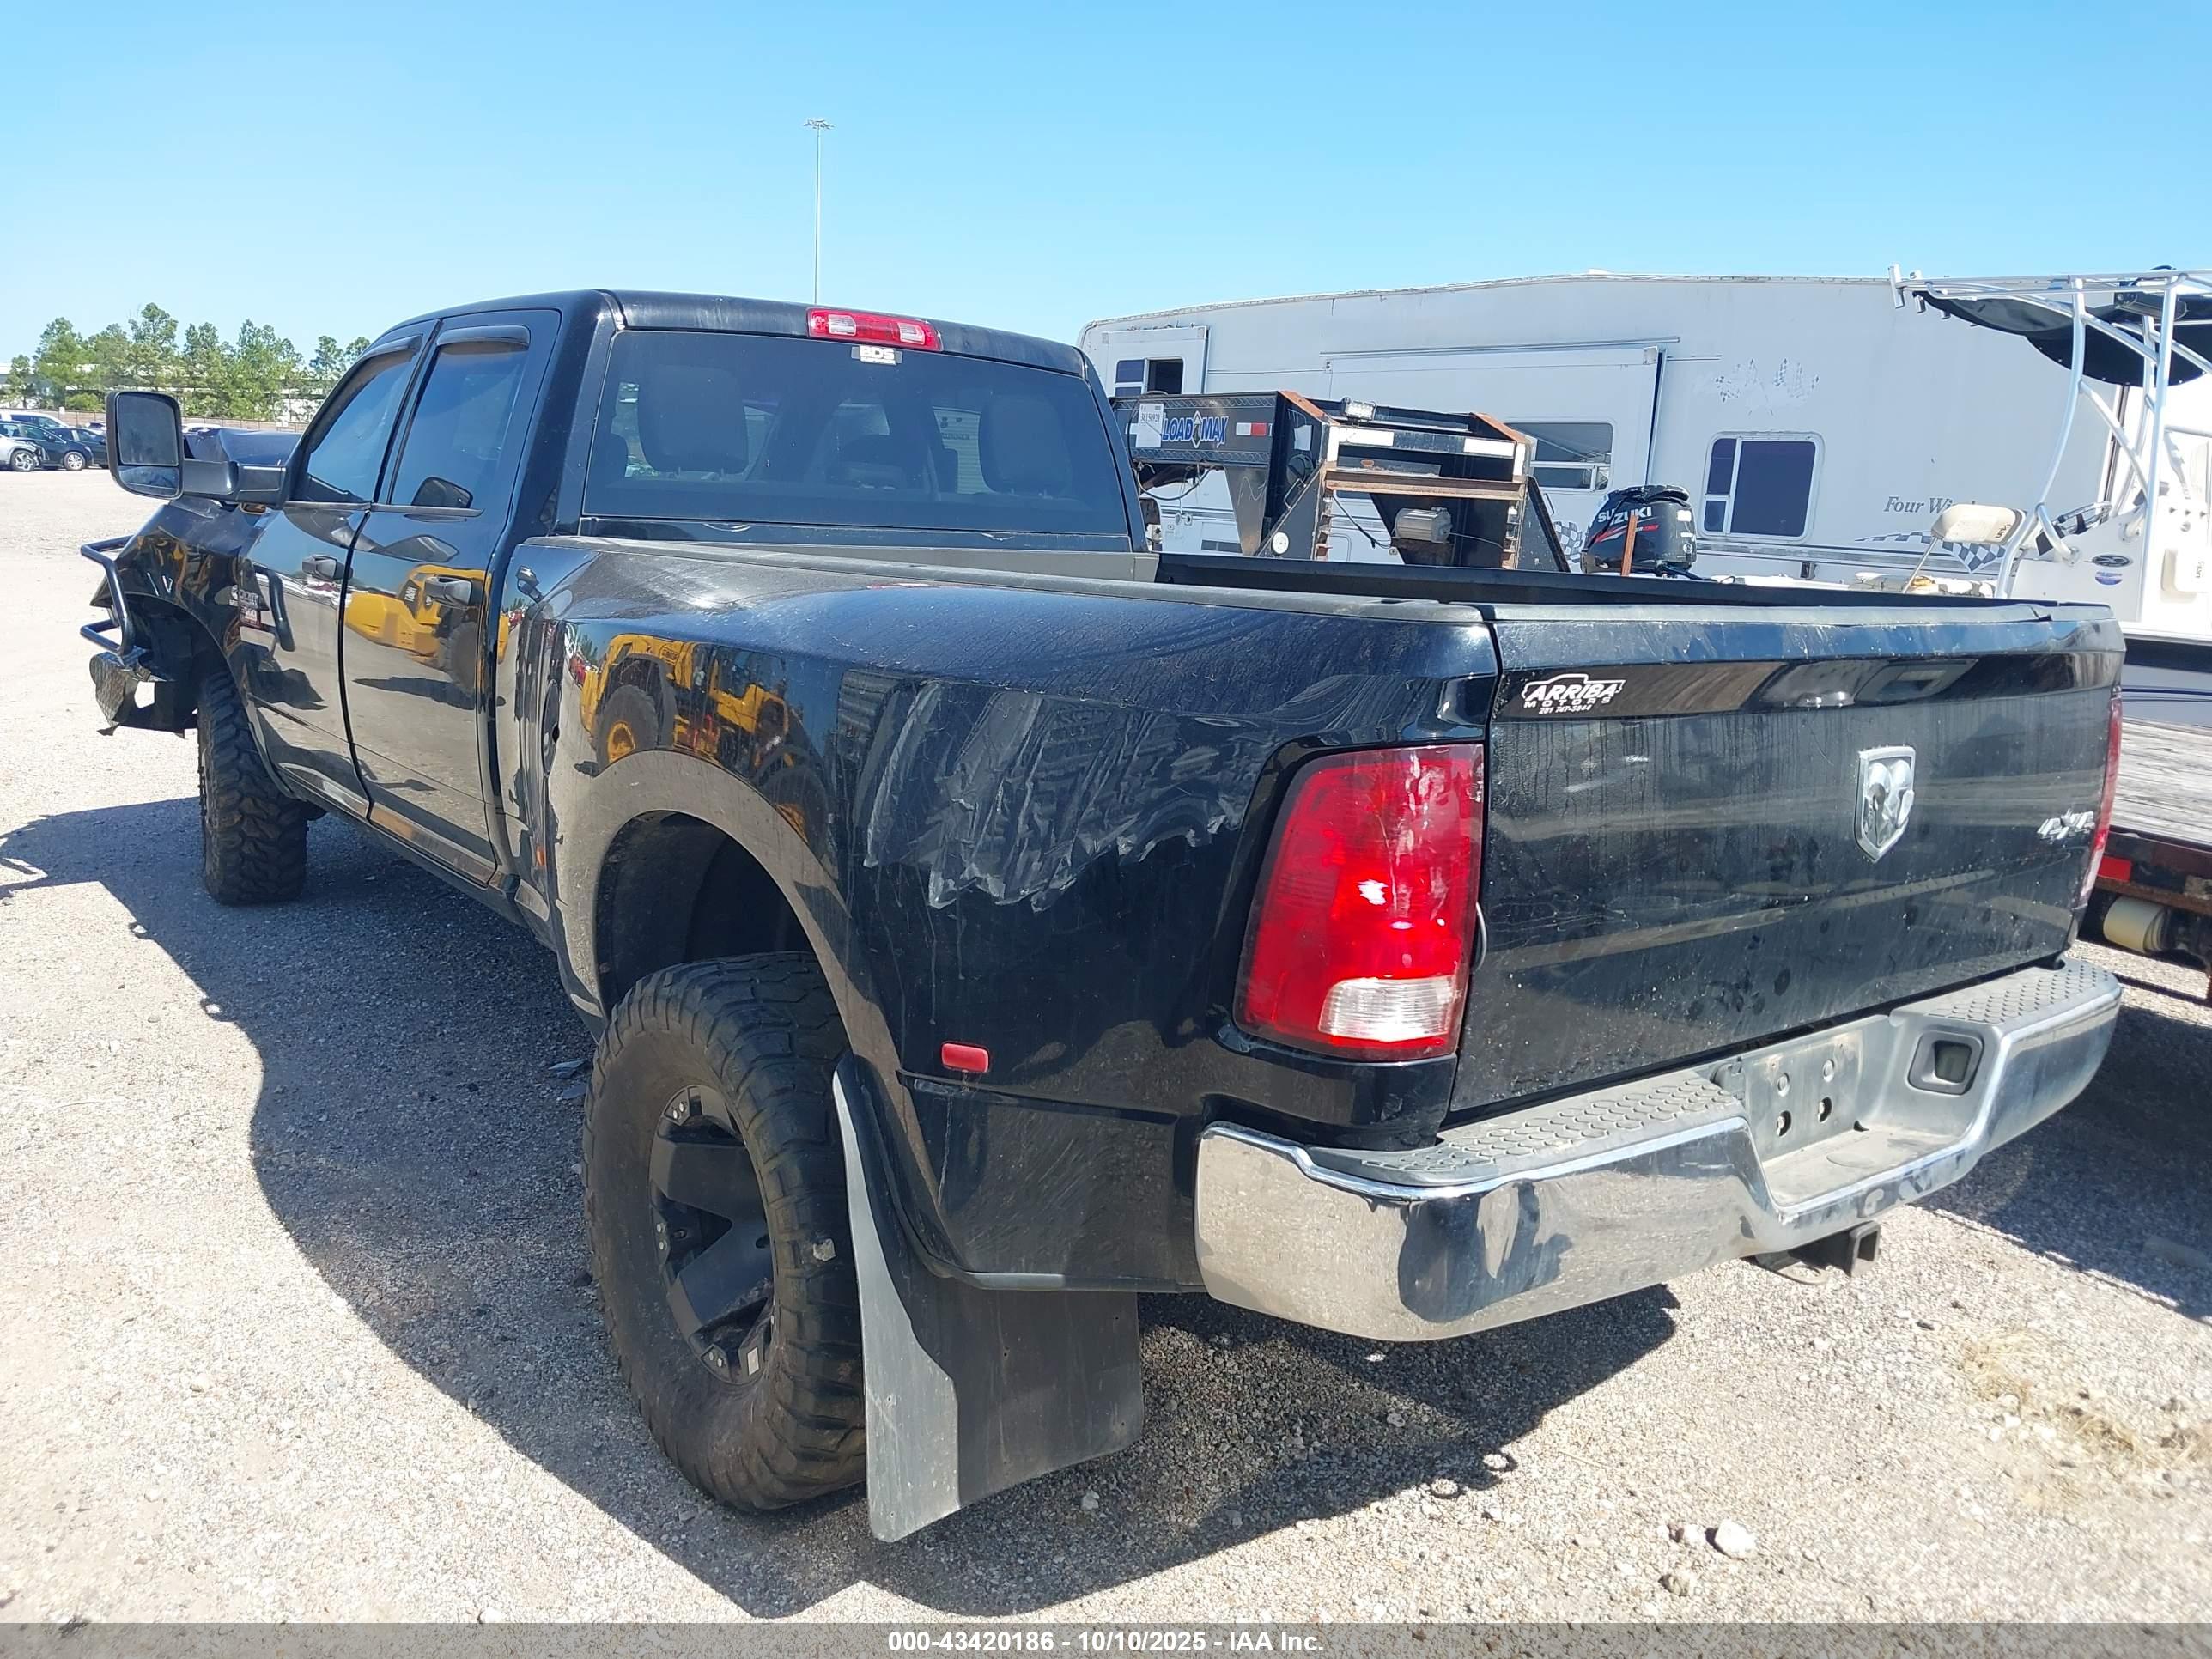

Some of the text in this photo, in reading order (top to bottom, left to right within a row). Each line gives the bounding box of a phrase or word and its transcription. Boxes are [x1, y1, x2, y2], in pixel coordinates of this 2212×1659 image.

[860, 345, 895, 361] BDS
[1161, 416, 1230, 446] LOAD MAX
[1883, 495, 1925, 514] Four
[1523, 696, 1612, 708] MOTORS
[1524, 683, 1618, 702] ARRIBA
